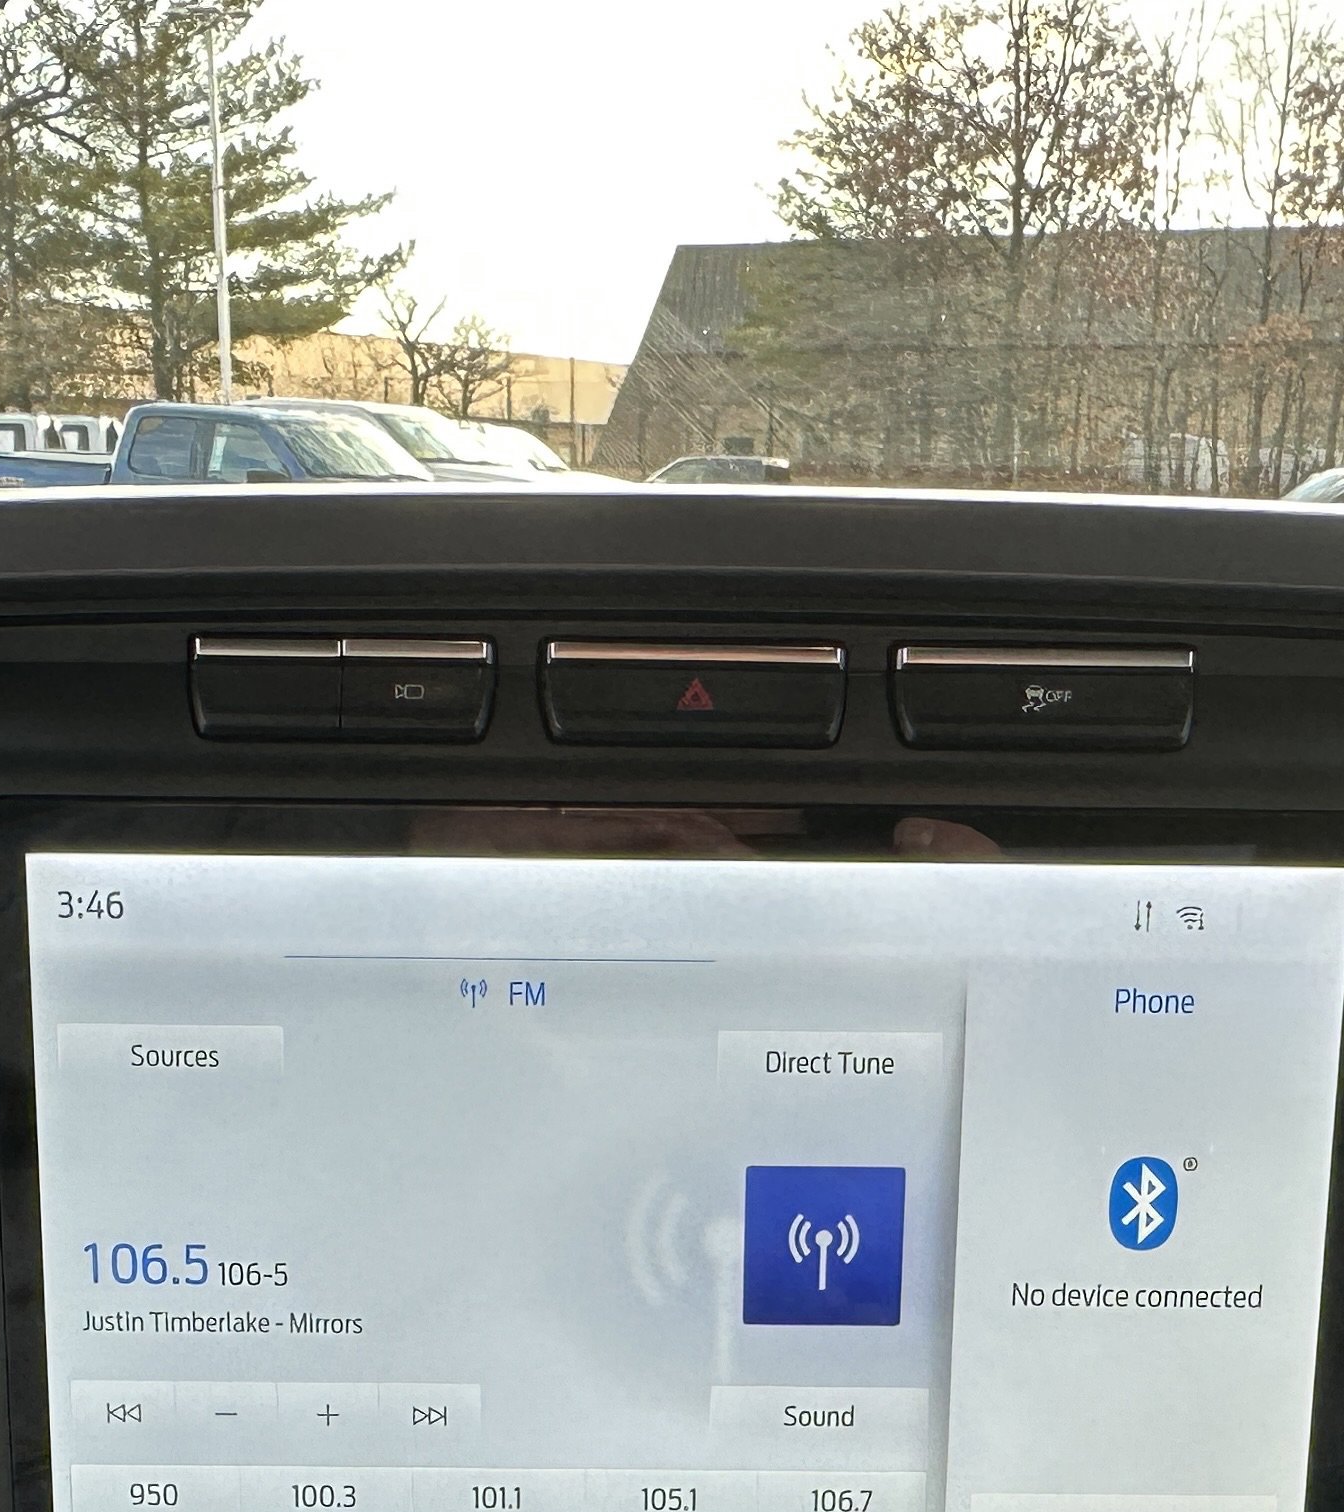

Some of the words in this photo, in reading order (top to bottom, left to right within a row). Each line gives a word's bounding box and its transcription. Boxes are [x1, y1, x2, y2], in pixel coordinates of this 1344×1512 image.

[57, 889, 124, 920] 3:46
[509, 981, 545, 1007] FM
[1115, 987, 1195, 1014] Phone
[131, 1044, 220, 1068] Sources
[766, 1050, 832, 1074] Direct
[837, 1051, 895, 1075] Tune
[83, 1242, 209, 1285] 106.5
[218, 1262, 288, 1287] 106-5
[1012, 1282, 1045, 1307] No
[1051, 1282, 1129, 1308] device
[1135, 1284, 1263, 1309] connected
[82, 1310, 144, 1332] Justin
[148, 1310, 270, 1333] Timberlake
[290, 1312, 363, 1334] Mirrors
[783, 1404, 855, 1427] Sound
[130, 1483, 178, 1506] 950
[291, 1484, 356, 1508] 100.3
[472, 1486, 521, 1510] 101.1
[641, 1487, 697, 1512] 105.1
[811, 1489, 873, 1512] 106.7
